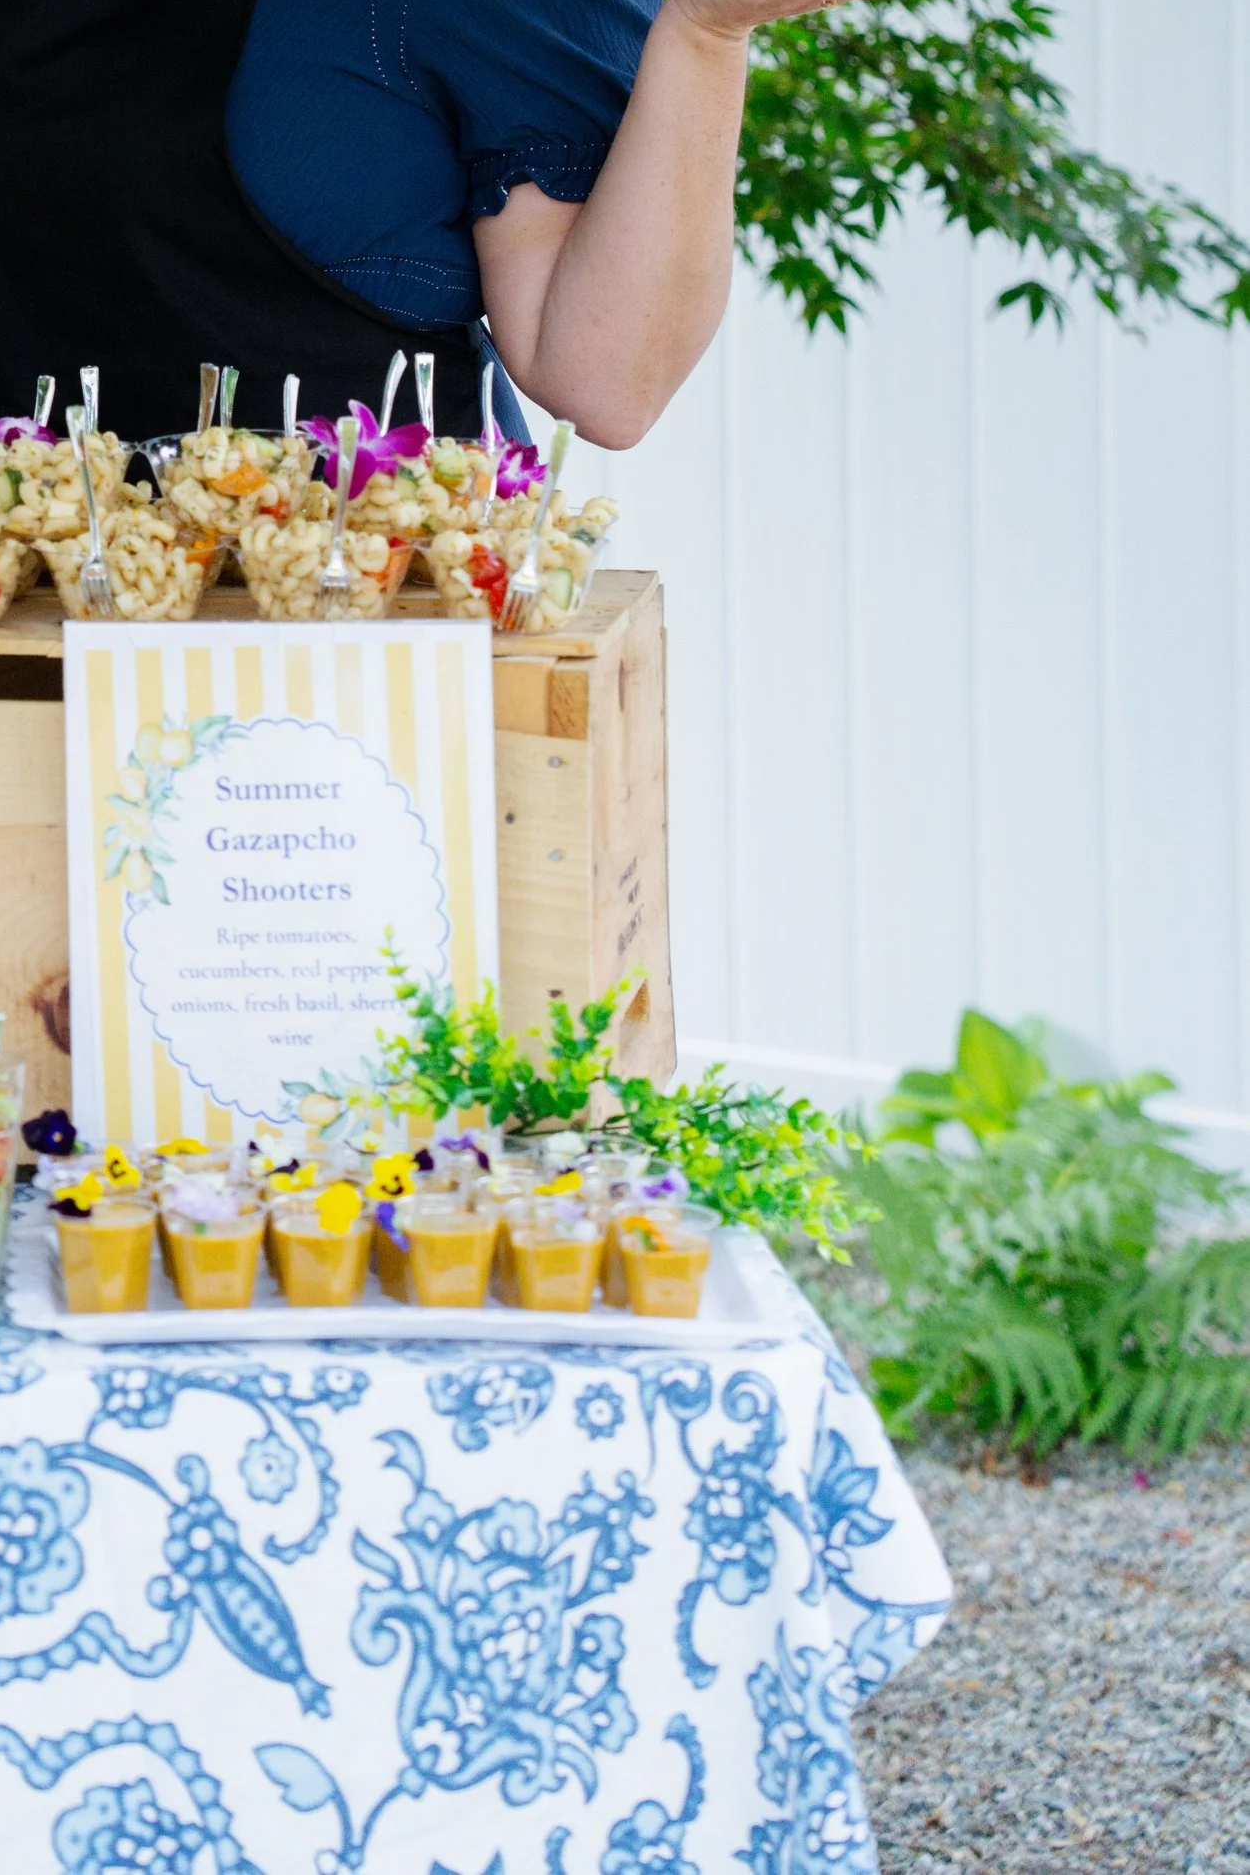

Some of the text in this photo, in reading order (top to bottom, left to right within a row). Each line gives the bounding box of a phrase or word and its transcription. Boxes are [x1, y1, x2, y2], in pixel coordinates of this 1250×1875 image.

[215, 776, 343, 801] Summer
[206, 827, 356, 858] Gazapcho
[223, 877, 352, 902] Shooters
[216, 928, 260, 949] Ripe
[291, 960, 321, 977] red
[327, 963, 395, 984] peppe
[244, 993, 290, 1012] fresh
[267, 1030, 314, 1046] wine
